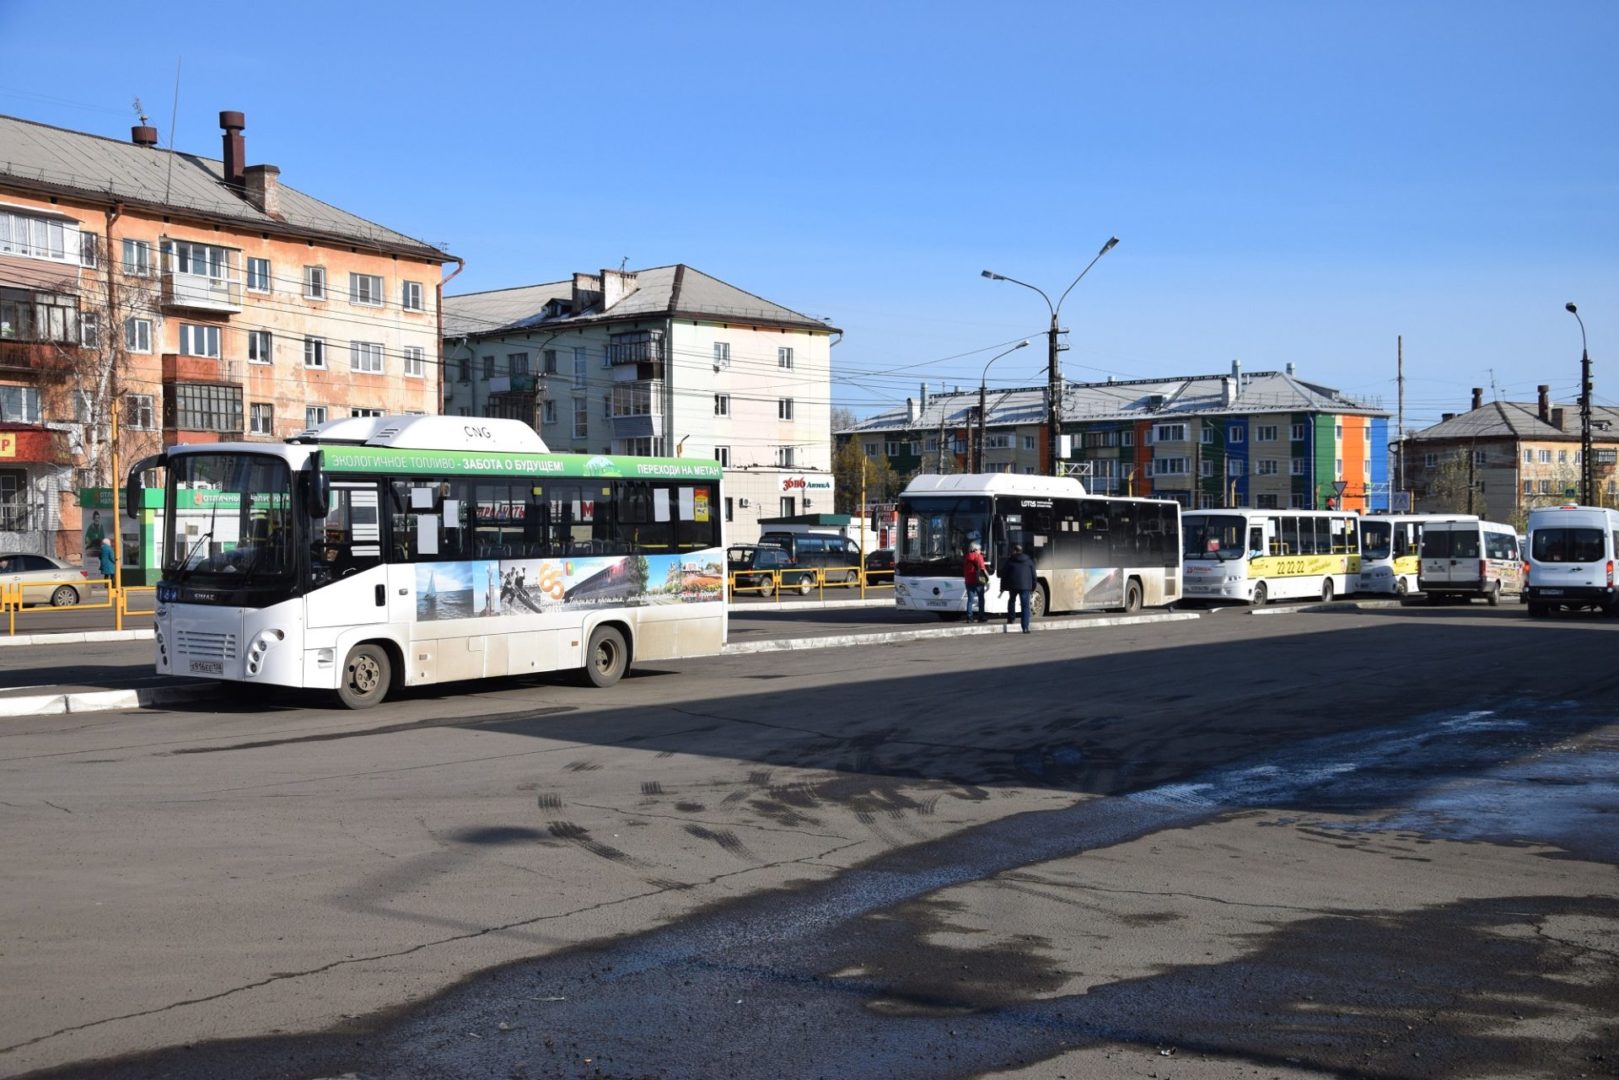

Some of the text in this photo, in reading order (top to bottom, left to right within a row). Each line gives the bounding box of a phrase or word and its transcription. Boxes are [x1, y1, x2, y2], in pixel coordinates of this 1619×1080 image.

[463, 425, 492, 439] CNG
[331, 455, 408, 468] ЭКОЛОГИЧНОЕ
[411, 457, 455, 469] ТОПЛИВО
[463, 458, 503, 470] ЗАБОТА
[505, 459, 513, 470] О
[515, 460, 564, 473] БУДУЩЕМ!
[637, 464, 720, 476] ПЕРЕХОДИ НА МЕТАН
[1277, 561, 1285, 574] 22
[1287, 560, 1295, 574] 22
[1297, 560, 1305, 573] 22
